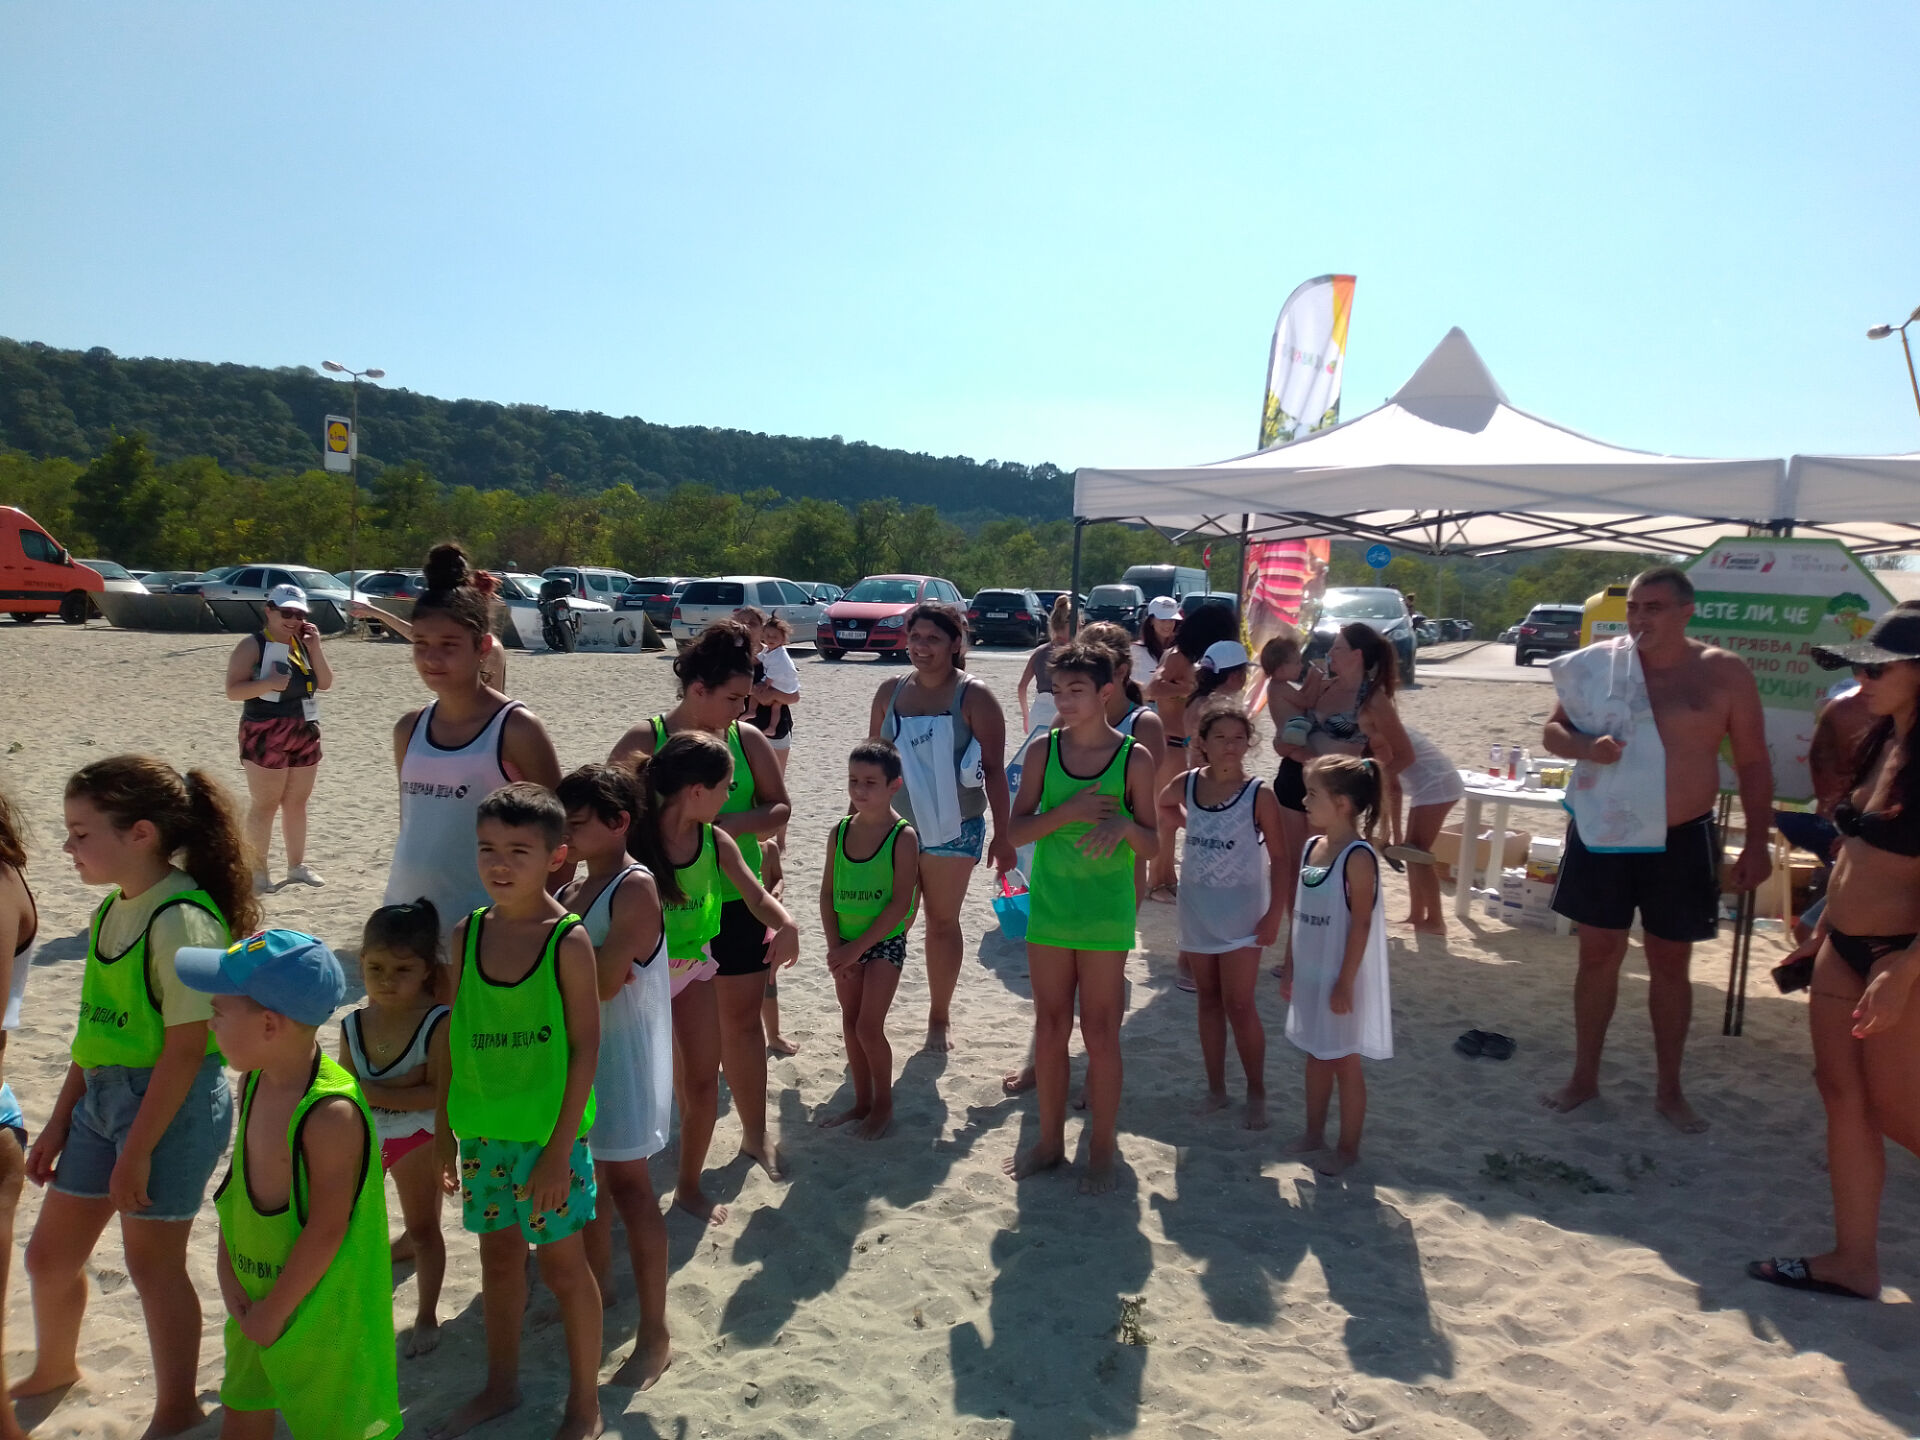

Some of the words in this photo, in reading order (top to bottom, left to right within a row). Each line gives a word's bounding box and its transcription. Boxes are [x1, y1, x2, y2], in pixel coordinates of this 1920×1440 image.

[1694, 601, 1739, 620] АЕТЕ
[1742, 604, 1778, 625] ЛИ,
[1783, 606, 1810, 625] ЧЕ
[1727, 636, 1792, 653] ТРЯБВА
[1786, 660, 1809, 674] ПО
[471, 1032, 508, 1051] ЗДРАВИ
[511, 1030, 536, 1049] ДЕЦА
